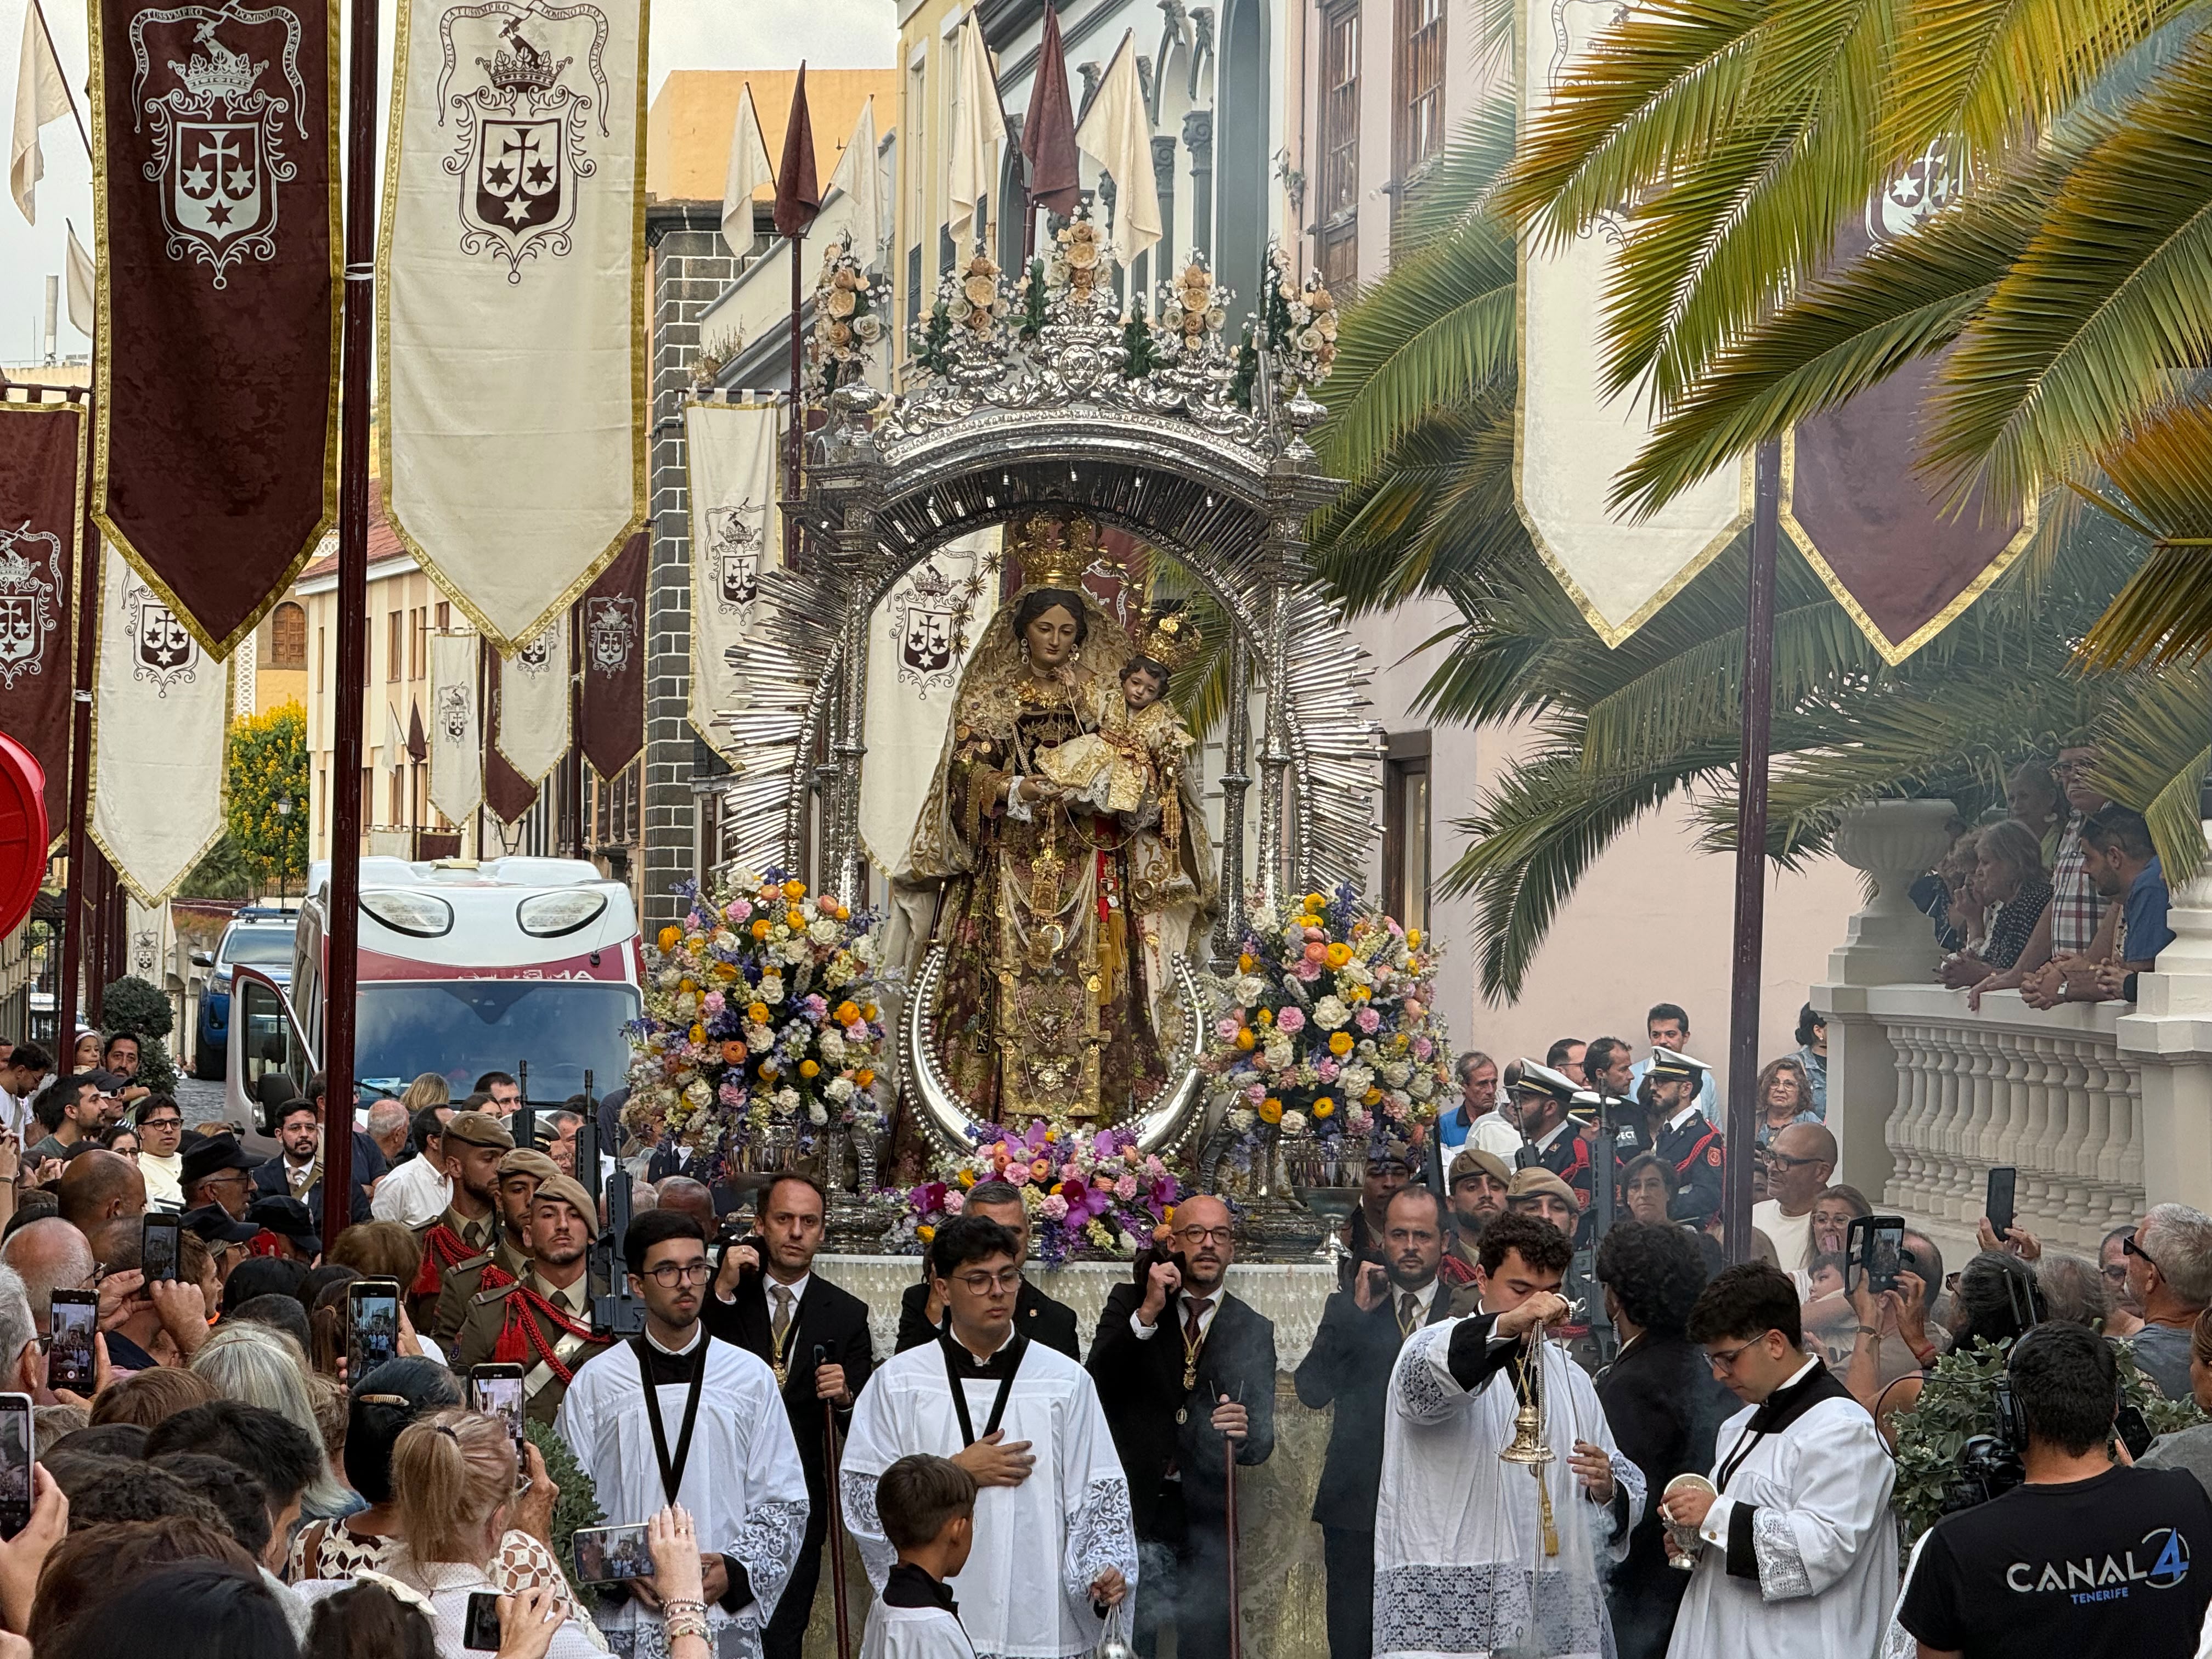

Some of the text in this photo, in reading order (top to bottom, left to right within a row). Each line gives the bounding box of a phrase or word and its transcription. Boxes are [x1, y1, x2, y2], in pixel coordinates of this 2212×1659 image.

[137, 48, 147, 75] ZELO
[2006, 1551, 2148, 1592] CANAL
[2070, 1587, 2129, 1605] TENERIFE
